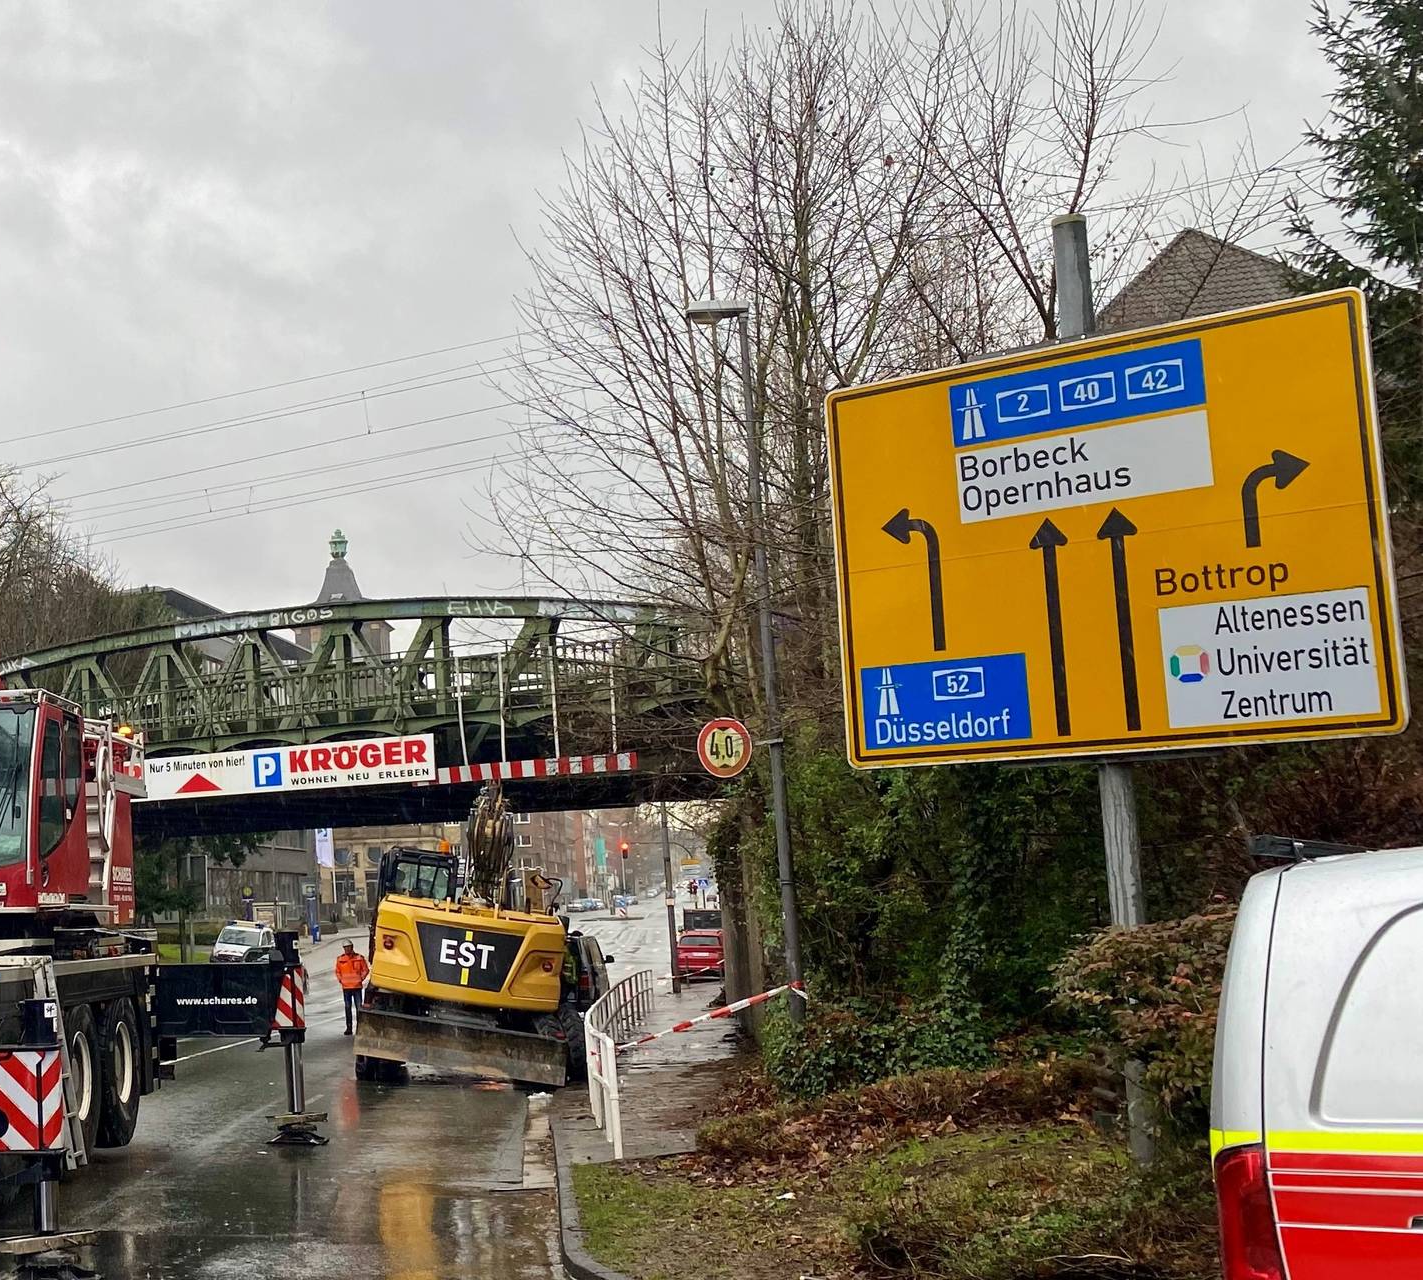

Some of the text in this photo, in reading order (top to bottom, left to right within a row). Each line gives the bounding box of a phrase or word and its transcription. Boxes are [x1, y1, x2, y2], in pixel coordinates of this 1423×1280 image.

[1017, 369, 1168, 413] 2 40 42
[960, 437, 1089, 482] Borbeck
[963, 466, 1132, 516] Opernhaus
[1155, 562, 1289, 596] Bottrop
[1215, 599, 1365, 635] Altenessen
[1217, 637, 1370, 676] Universität
[947, 674, 970, 693] 52
[1221, 689, 1333, 719] Zentrum
[876, 708, 1010, 744] Düsseldorf
[149, 756, 245, 774] Nur 5 Minuten von hier!
[258, 757, 276, 785] P
[289, 739, 427, 773] KRÖGER
[291, 768, 430, 786] WOHNEN NEU ERLEBEN
[440, 938, 495, 970] EST
[177, 996, 258, 1006] www.schares.de
